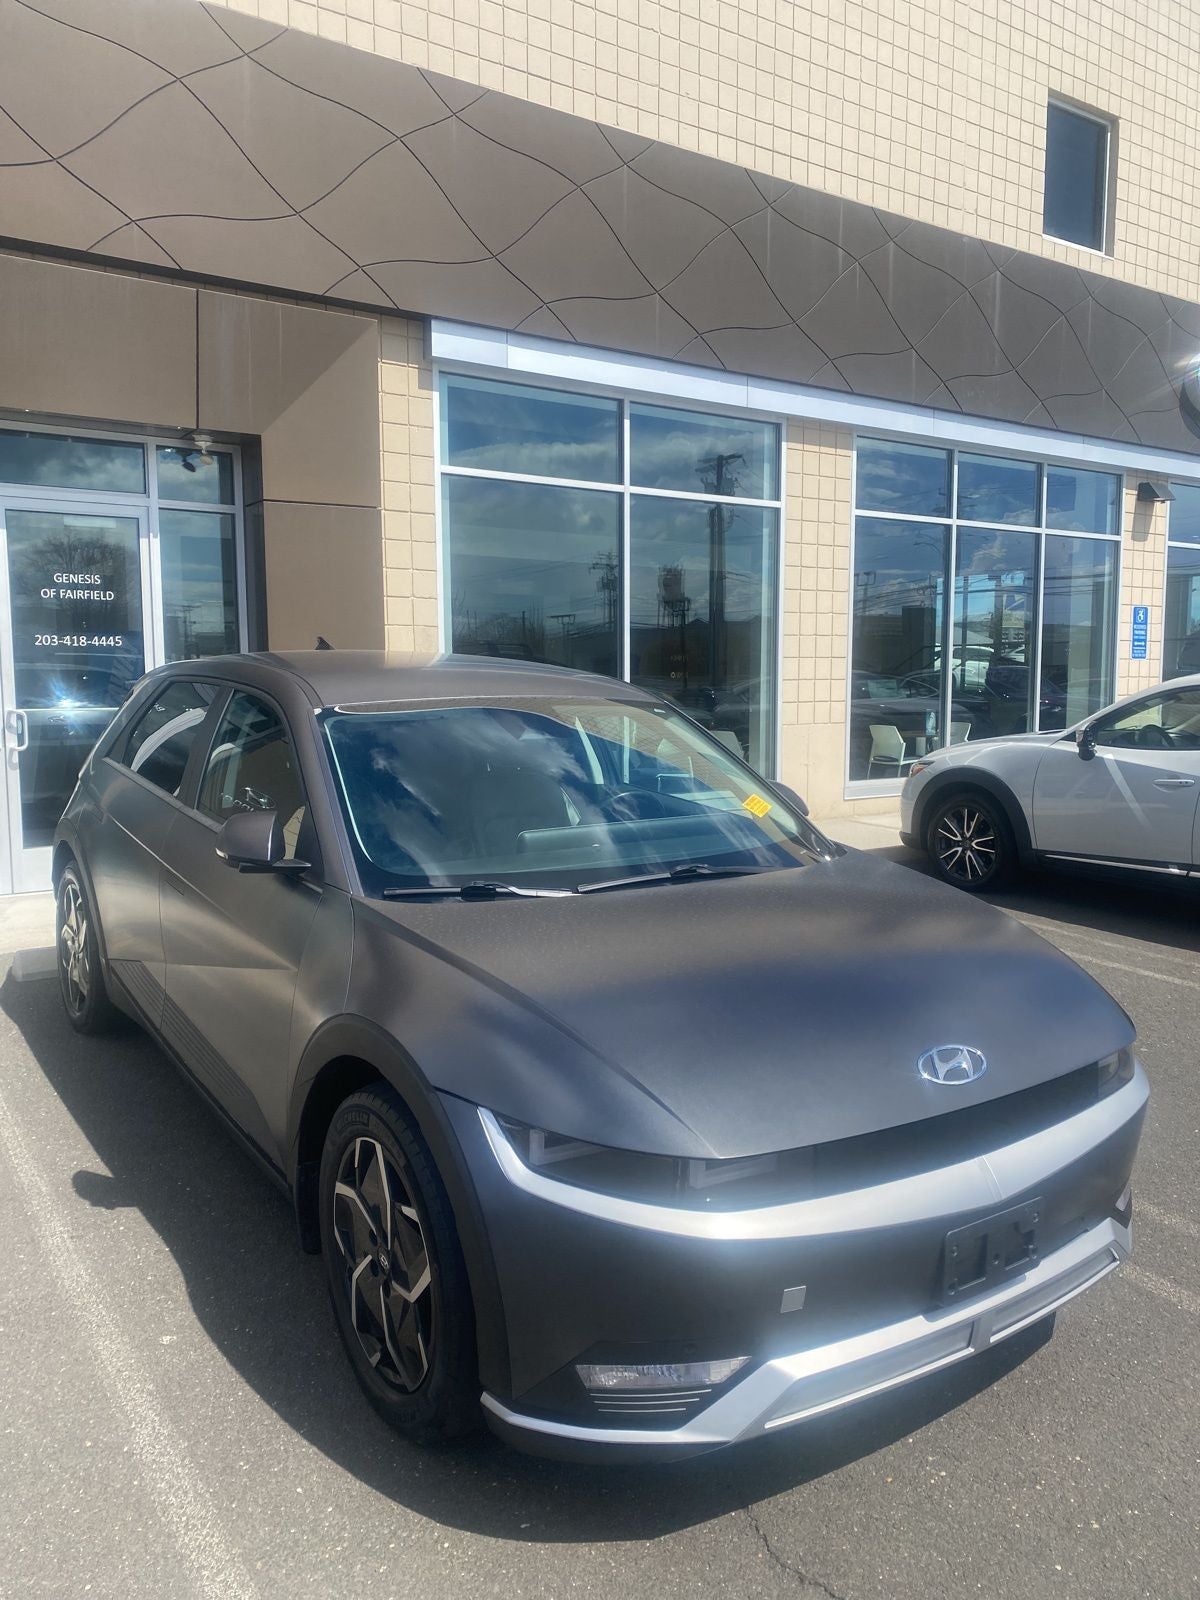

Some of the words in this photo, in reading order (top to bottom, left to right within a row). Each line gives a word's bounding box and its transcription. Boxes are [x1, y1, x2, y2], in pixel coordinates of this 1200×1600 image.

[53, 573, 101, 584] GENESIS
[40, 588, 57, 598] OF
[59, 589, 115, 600] FAIRFIELD
[34, 634, 123, 647] 203-418-4445
